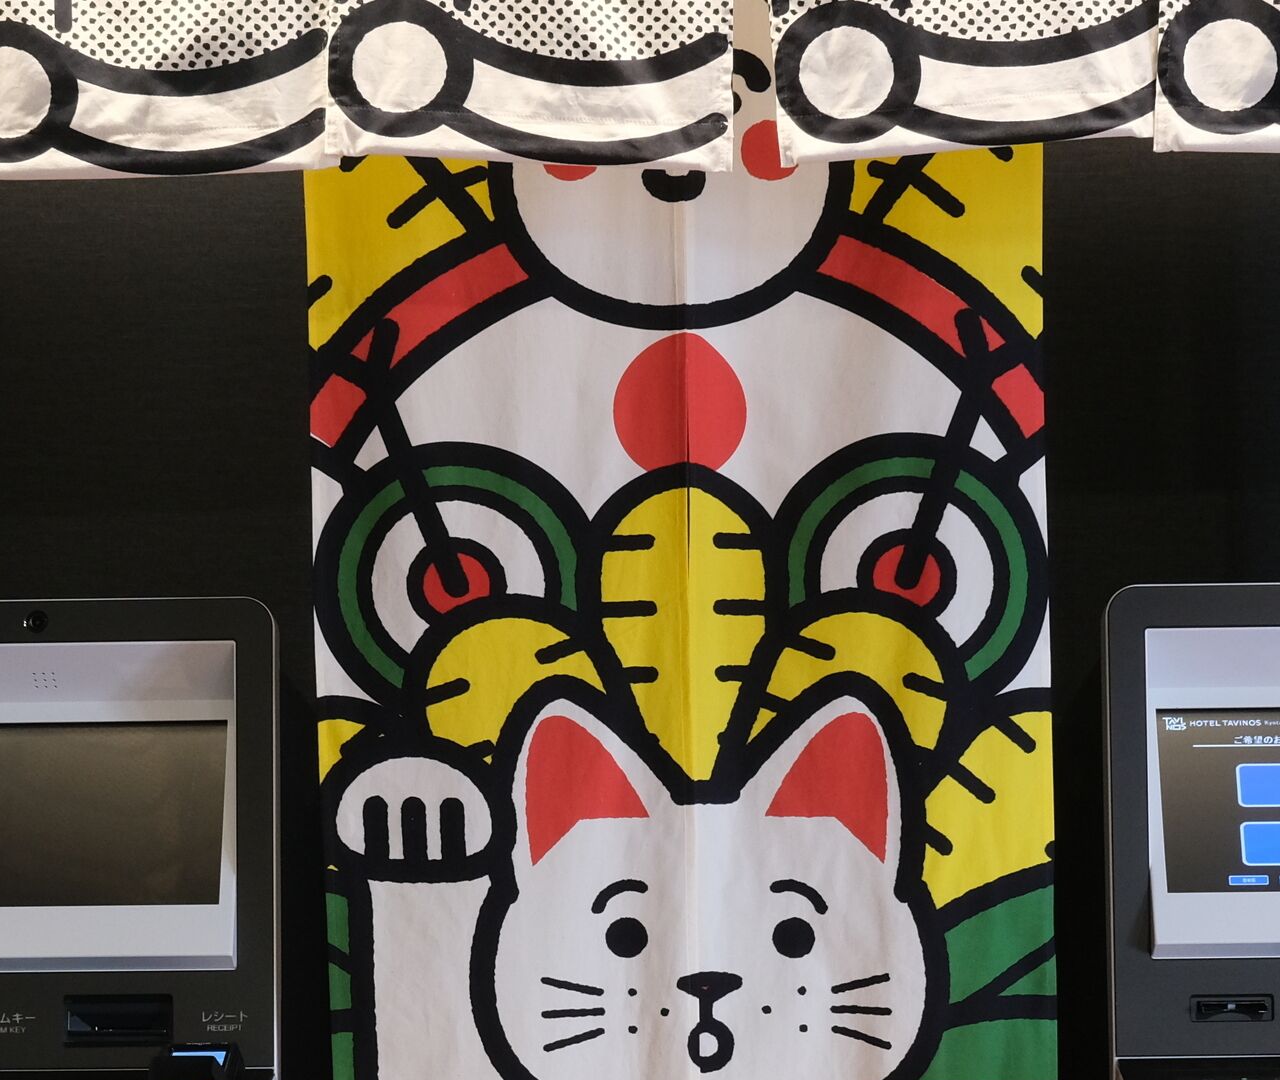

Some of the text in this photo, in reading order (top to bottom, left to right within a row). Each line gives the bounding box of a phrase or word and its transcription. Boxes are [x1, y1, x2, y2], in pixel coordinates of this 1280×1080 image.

[1189, 719, 1221, 727] HOTEL
[1222, 719, 1262, 727] TAVINOS
[201, 1010, 249, 1023] レシート
[9, 1026, 26, 1034] KEY
[206, 1024, 242, 1032] RECEIPT
